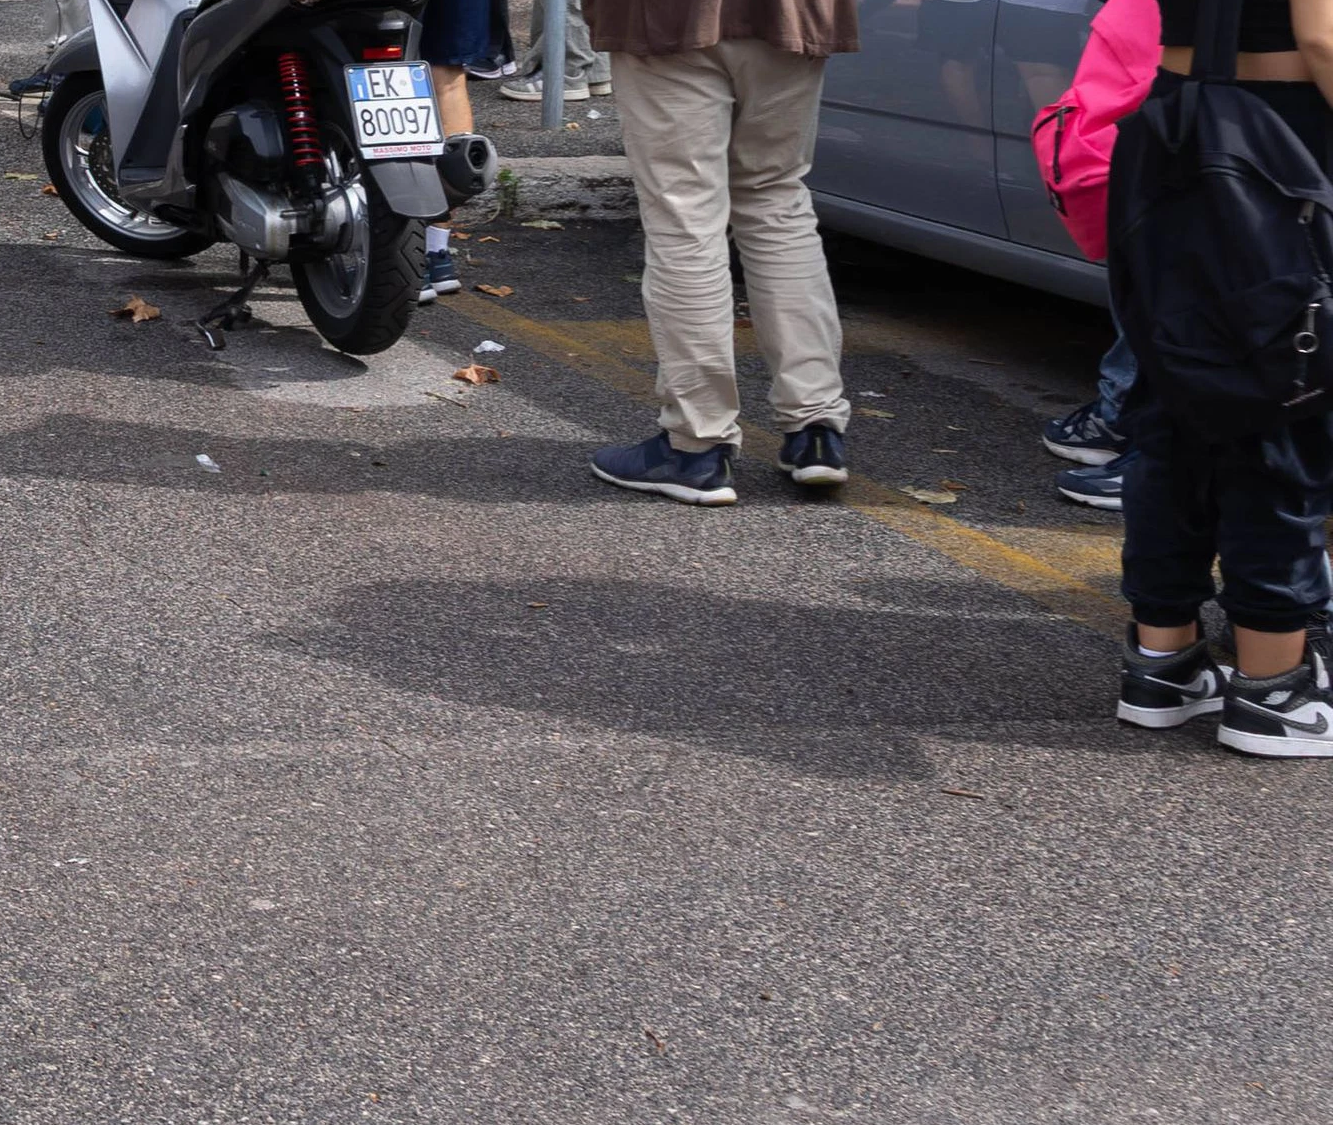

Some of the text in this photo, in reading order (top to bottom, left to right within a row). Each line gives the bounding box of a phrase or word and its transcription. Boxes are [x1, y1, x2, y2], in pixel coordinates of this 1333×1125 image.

[367, 69, 400, 98] EK
[361, 106, 431, 136] 80097
[373, 144, 432, 154] MASSIMO MOTO
